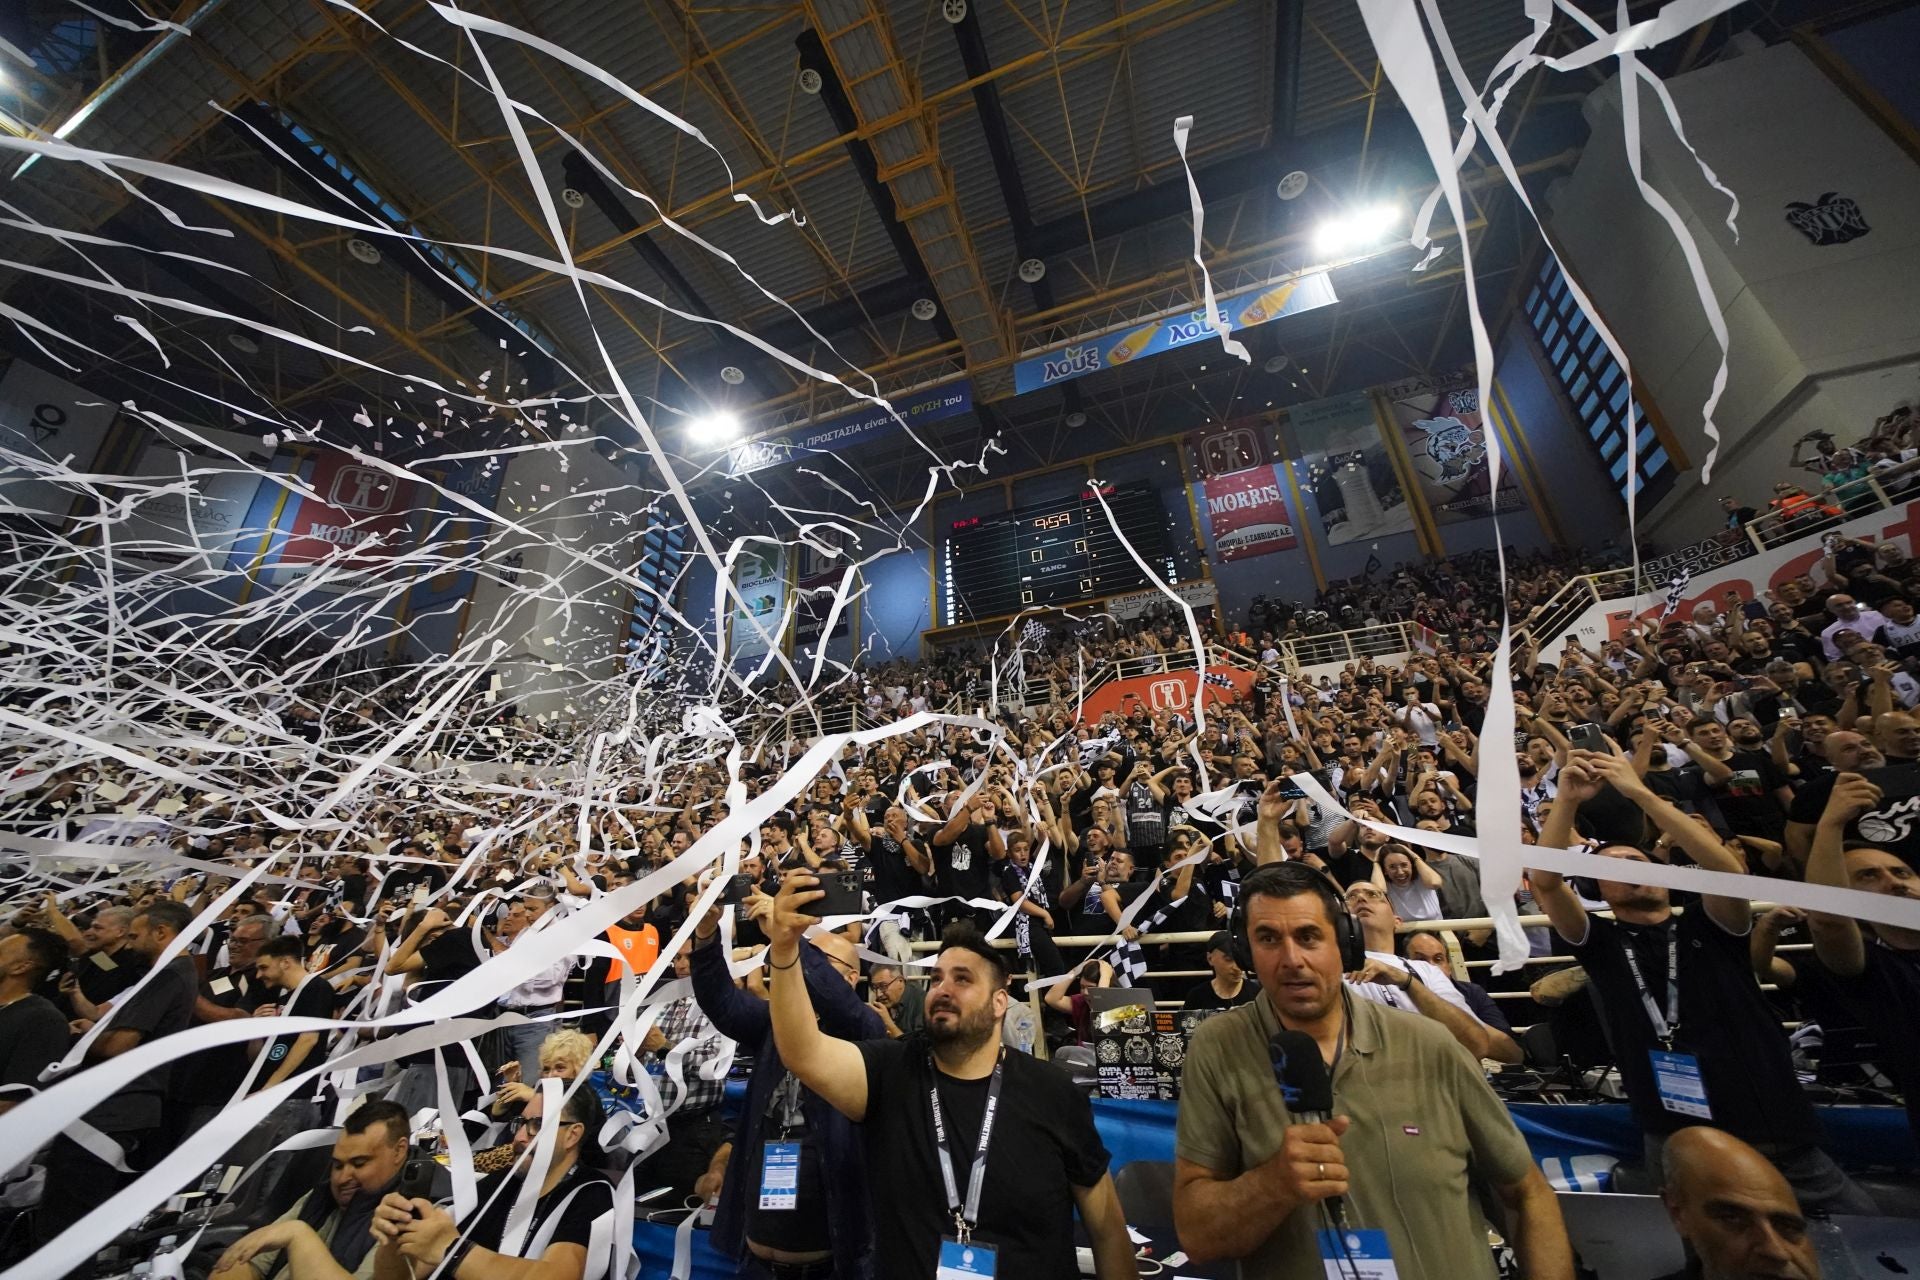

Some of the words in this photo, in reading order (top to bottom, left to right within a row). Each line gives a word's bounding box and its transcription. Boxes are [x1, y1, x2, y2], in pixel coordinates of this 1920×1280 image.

[806, 424, 862, 448] ΠΡΟΣΤΑΣΙΑ
[864, 416, 887, 430] είναι
[911, 400, 942, 416] ΦΥΣΗ
[944, 395, 962, 406] του
[1208, 485, 1280, 514] MORRIS
[1034, 513, 1070, 529] 9:59
[1652, 540, 1750, 588] BASKET
[741, 575, 777, 589] BIOCLIMA
[1580, 626, 1596, 636] 116
[1138, 798, 1152, 808] 24
[930, 1087, 945, 1142] FIBA.BASKETBALL
[978, 1096, 997, 1151] FIBA.BASKETBALL
